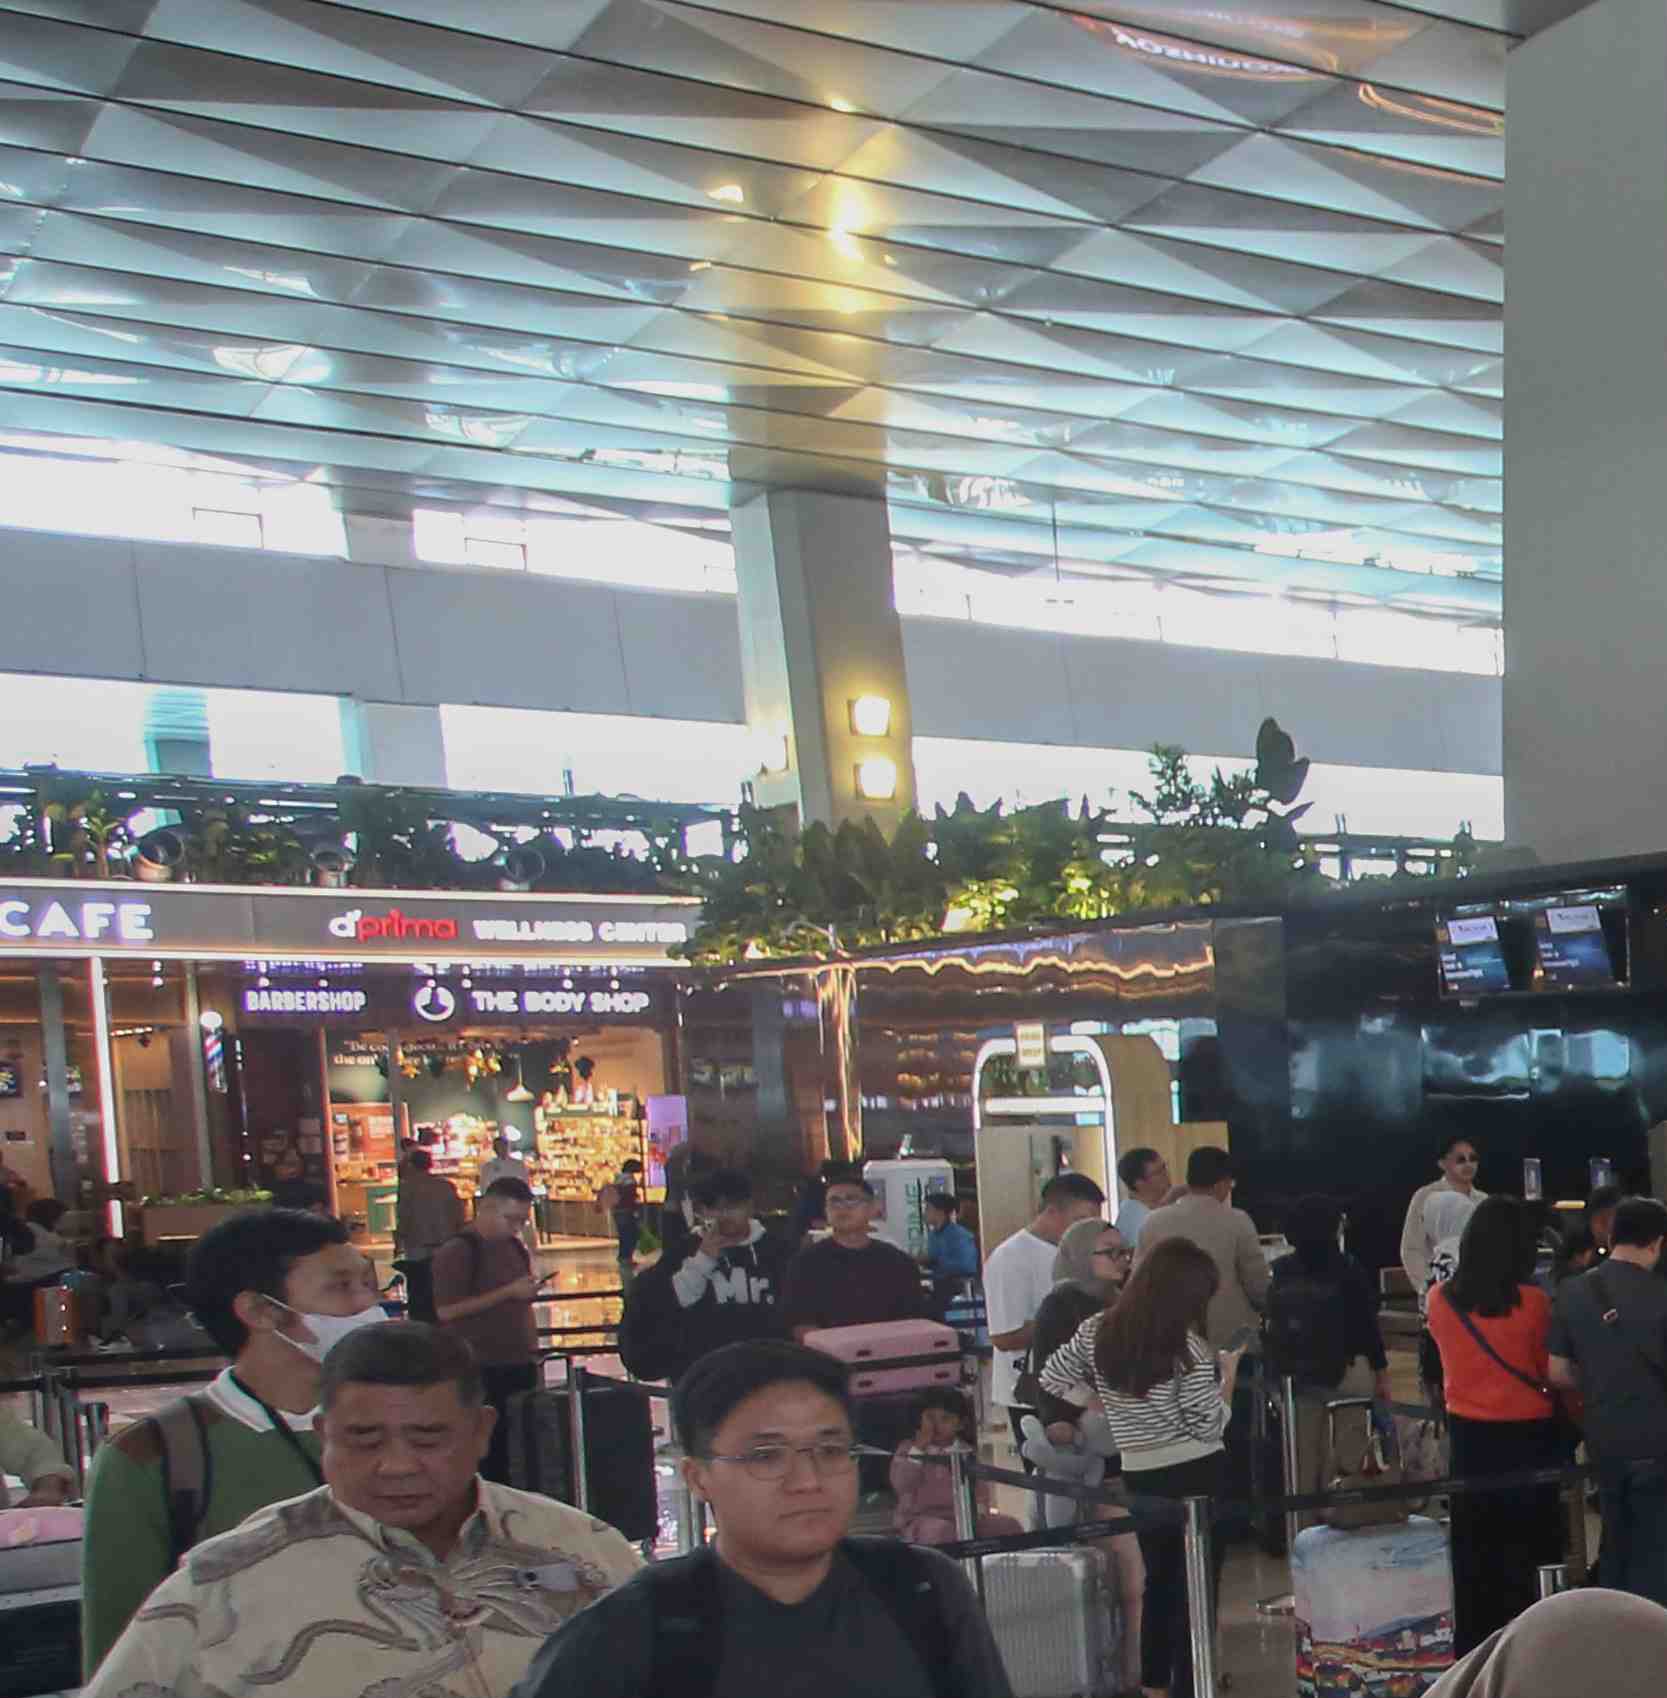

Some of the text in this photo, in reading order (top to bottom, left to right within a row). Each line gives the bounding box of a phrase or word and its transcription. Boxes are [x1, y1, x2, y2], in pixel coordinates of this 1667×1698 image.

[0, 900, 154, 940] CAFE
[598, 921, 688, 943] CENTER
[245, 990, 367, 1013] BARBERSHOP
[472, 990, 650, 1013] THE BODY SHOP
[711, 1266, 775, 1305] Mr.
